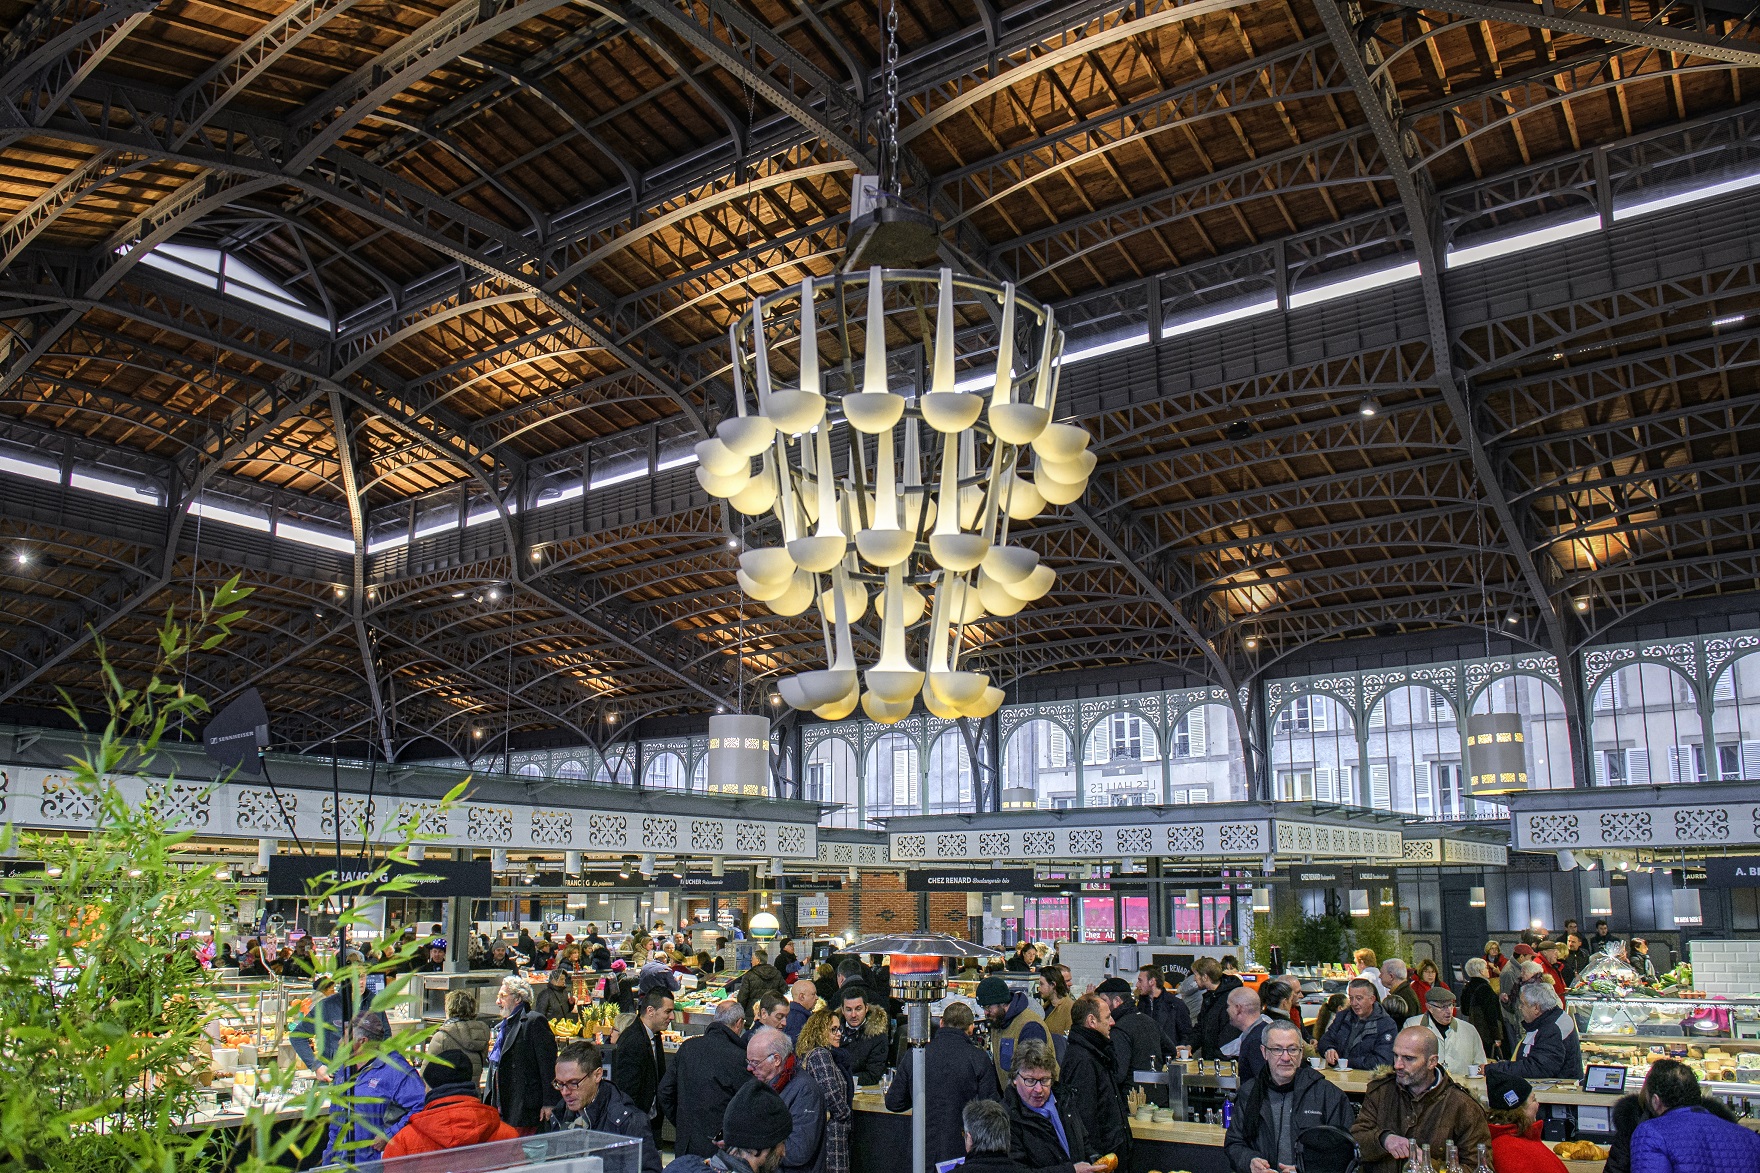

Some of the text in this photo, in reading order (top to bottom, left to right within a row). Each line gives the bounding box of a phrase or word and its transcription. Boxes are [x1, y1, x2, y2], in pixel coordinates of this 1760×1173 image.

[218, 731, 254, 742] SENNHEISER
[379, 872, 389, 883] G
[972, 877, 1001, 885] Boulangerie
[1001, 876, 1010, 884] bio
